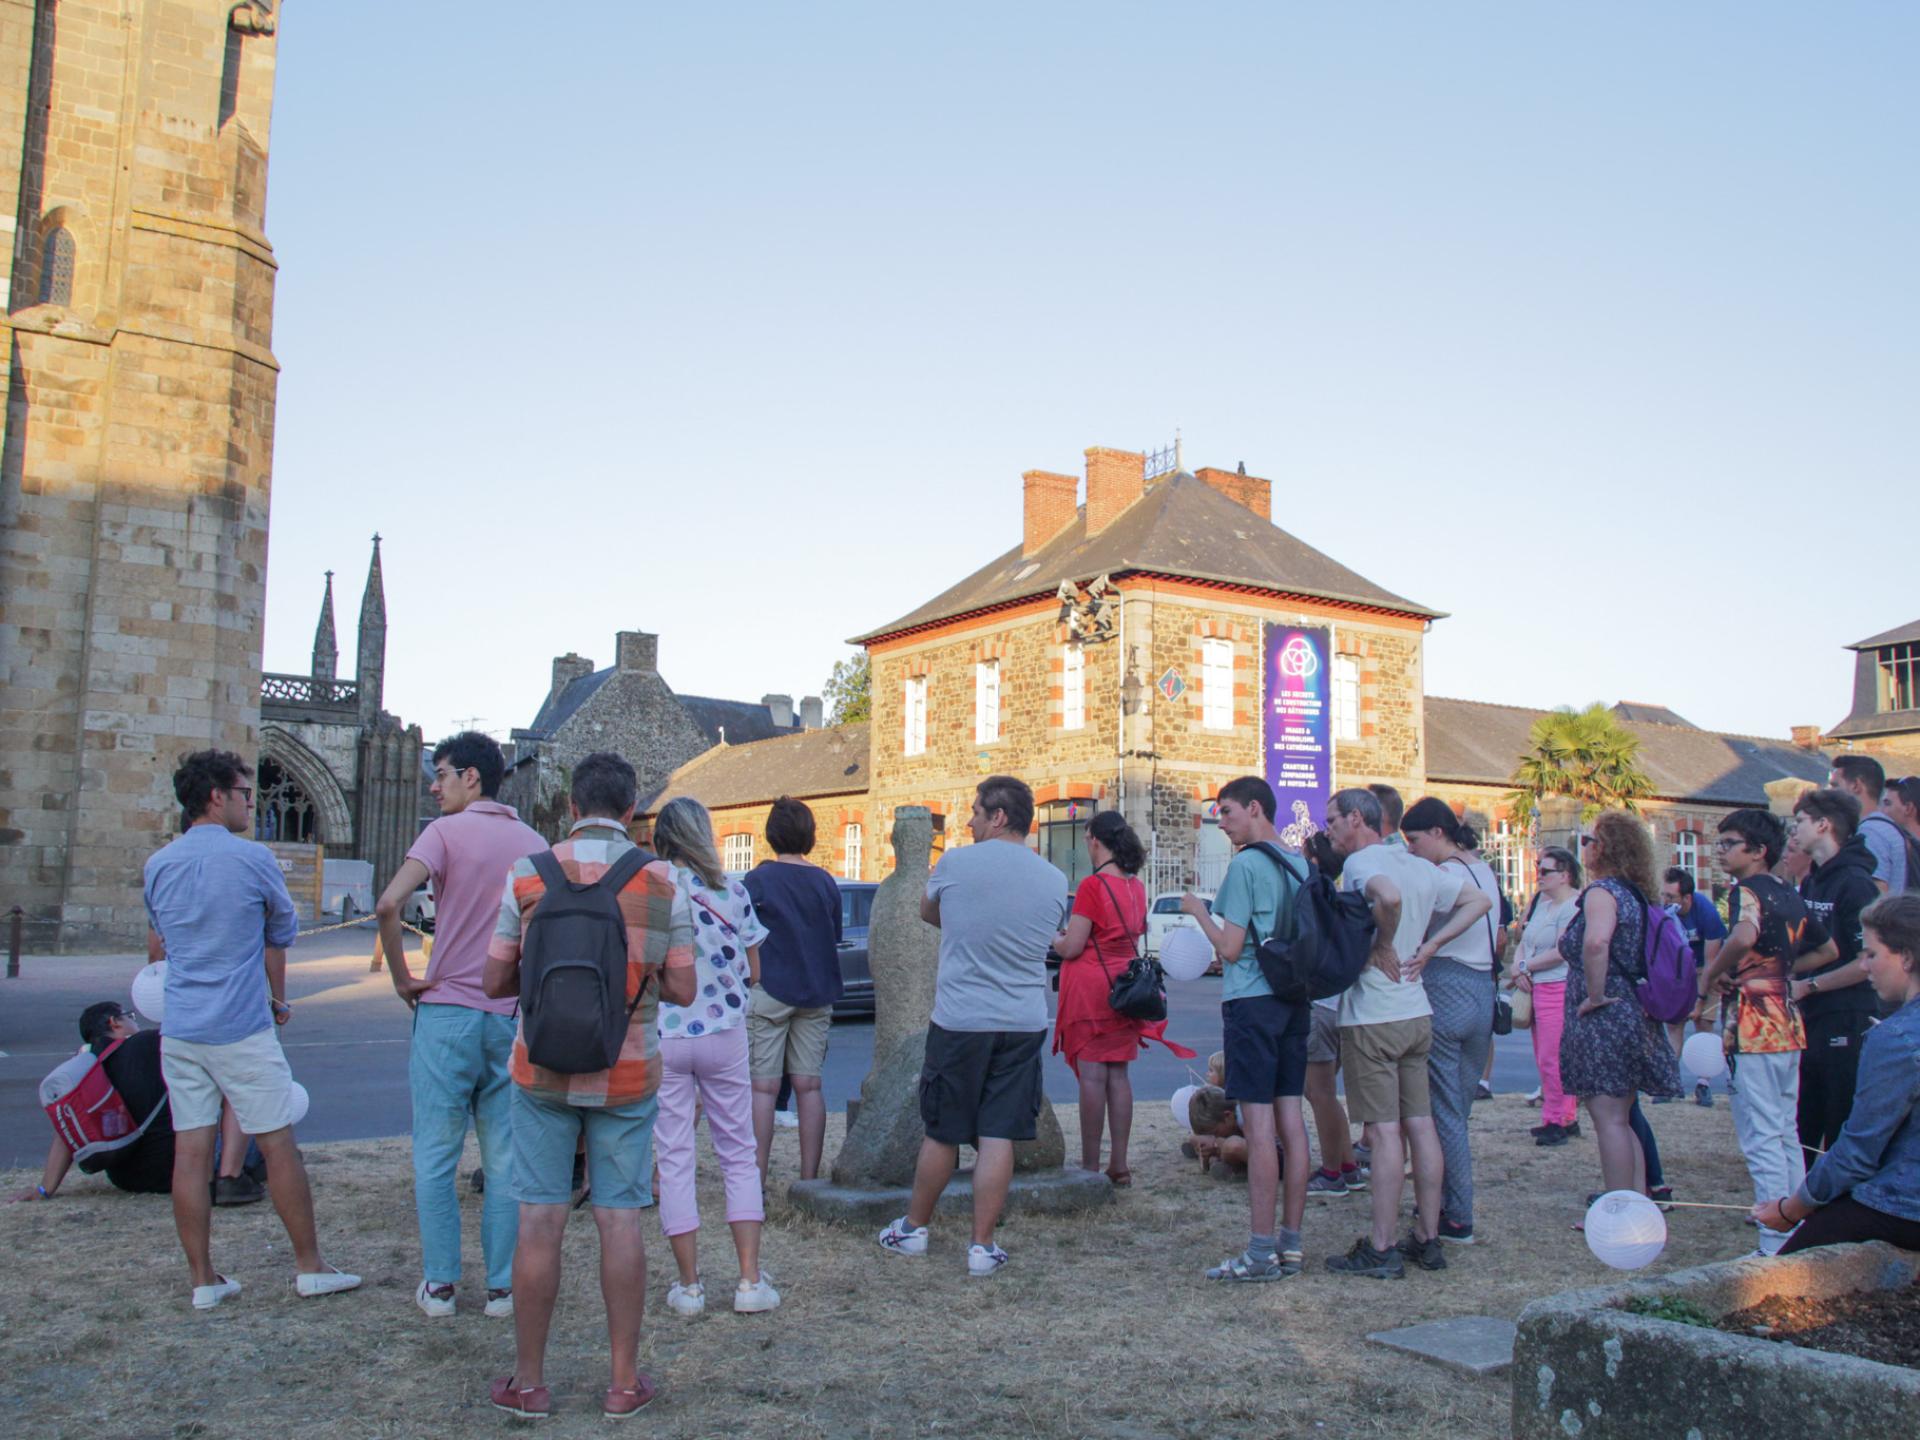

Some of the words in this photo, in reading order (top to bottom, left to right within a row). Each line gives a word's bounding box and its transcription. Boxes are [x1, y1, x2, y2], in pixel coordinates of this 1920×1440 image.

[1283, 699, 1322, 707] CONSTRUCTION
[1281, 735, 1315, 743] SYMBOLISME
[1286, 743, 1322, 752] CATHÉDRALES
[1280, 771, 1316, 779] COMPAGNONS
